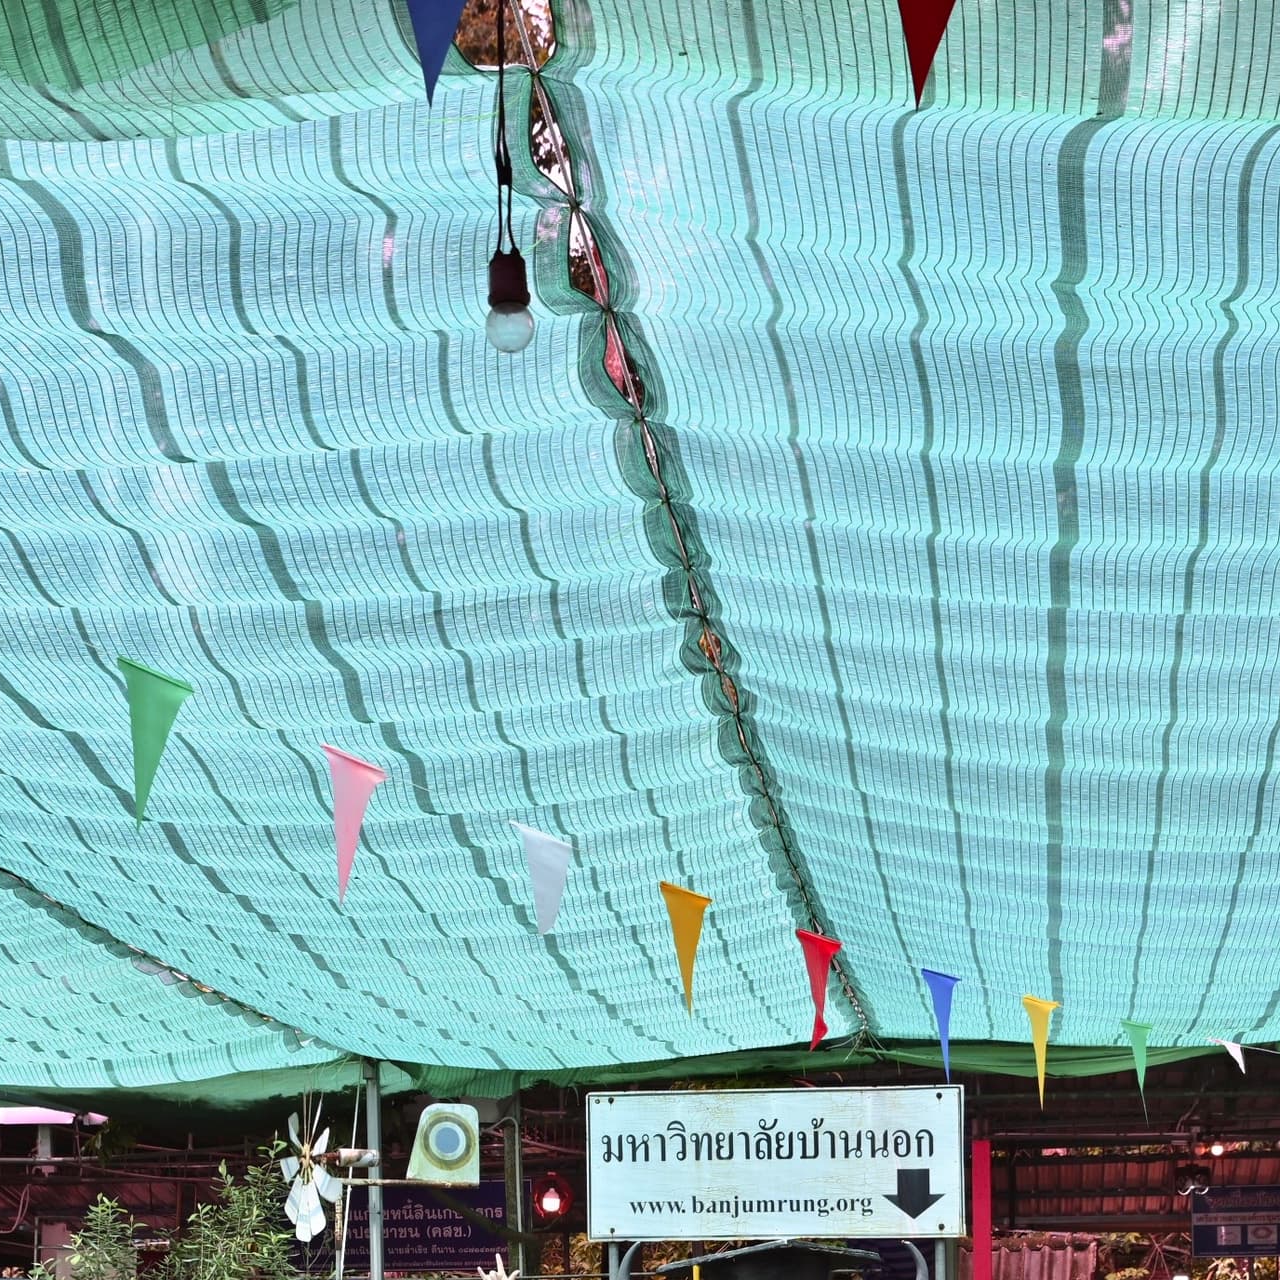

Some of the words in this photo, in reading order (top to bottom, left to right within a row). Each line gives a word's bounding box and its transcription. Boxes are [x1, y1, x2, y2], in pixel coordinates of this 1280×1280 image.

[601, 1118, 934, 1163] มหาวิทยาลัยบ้านนอก
